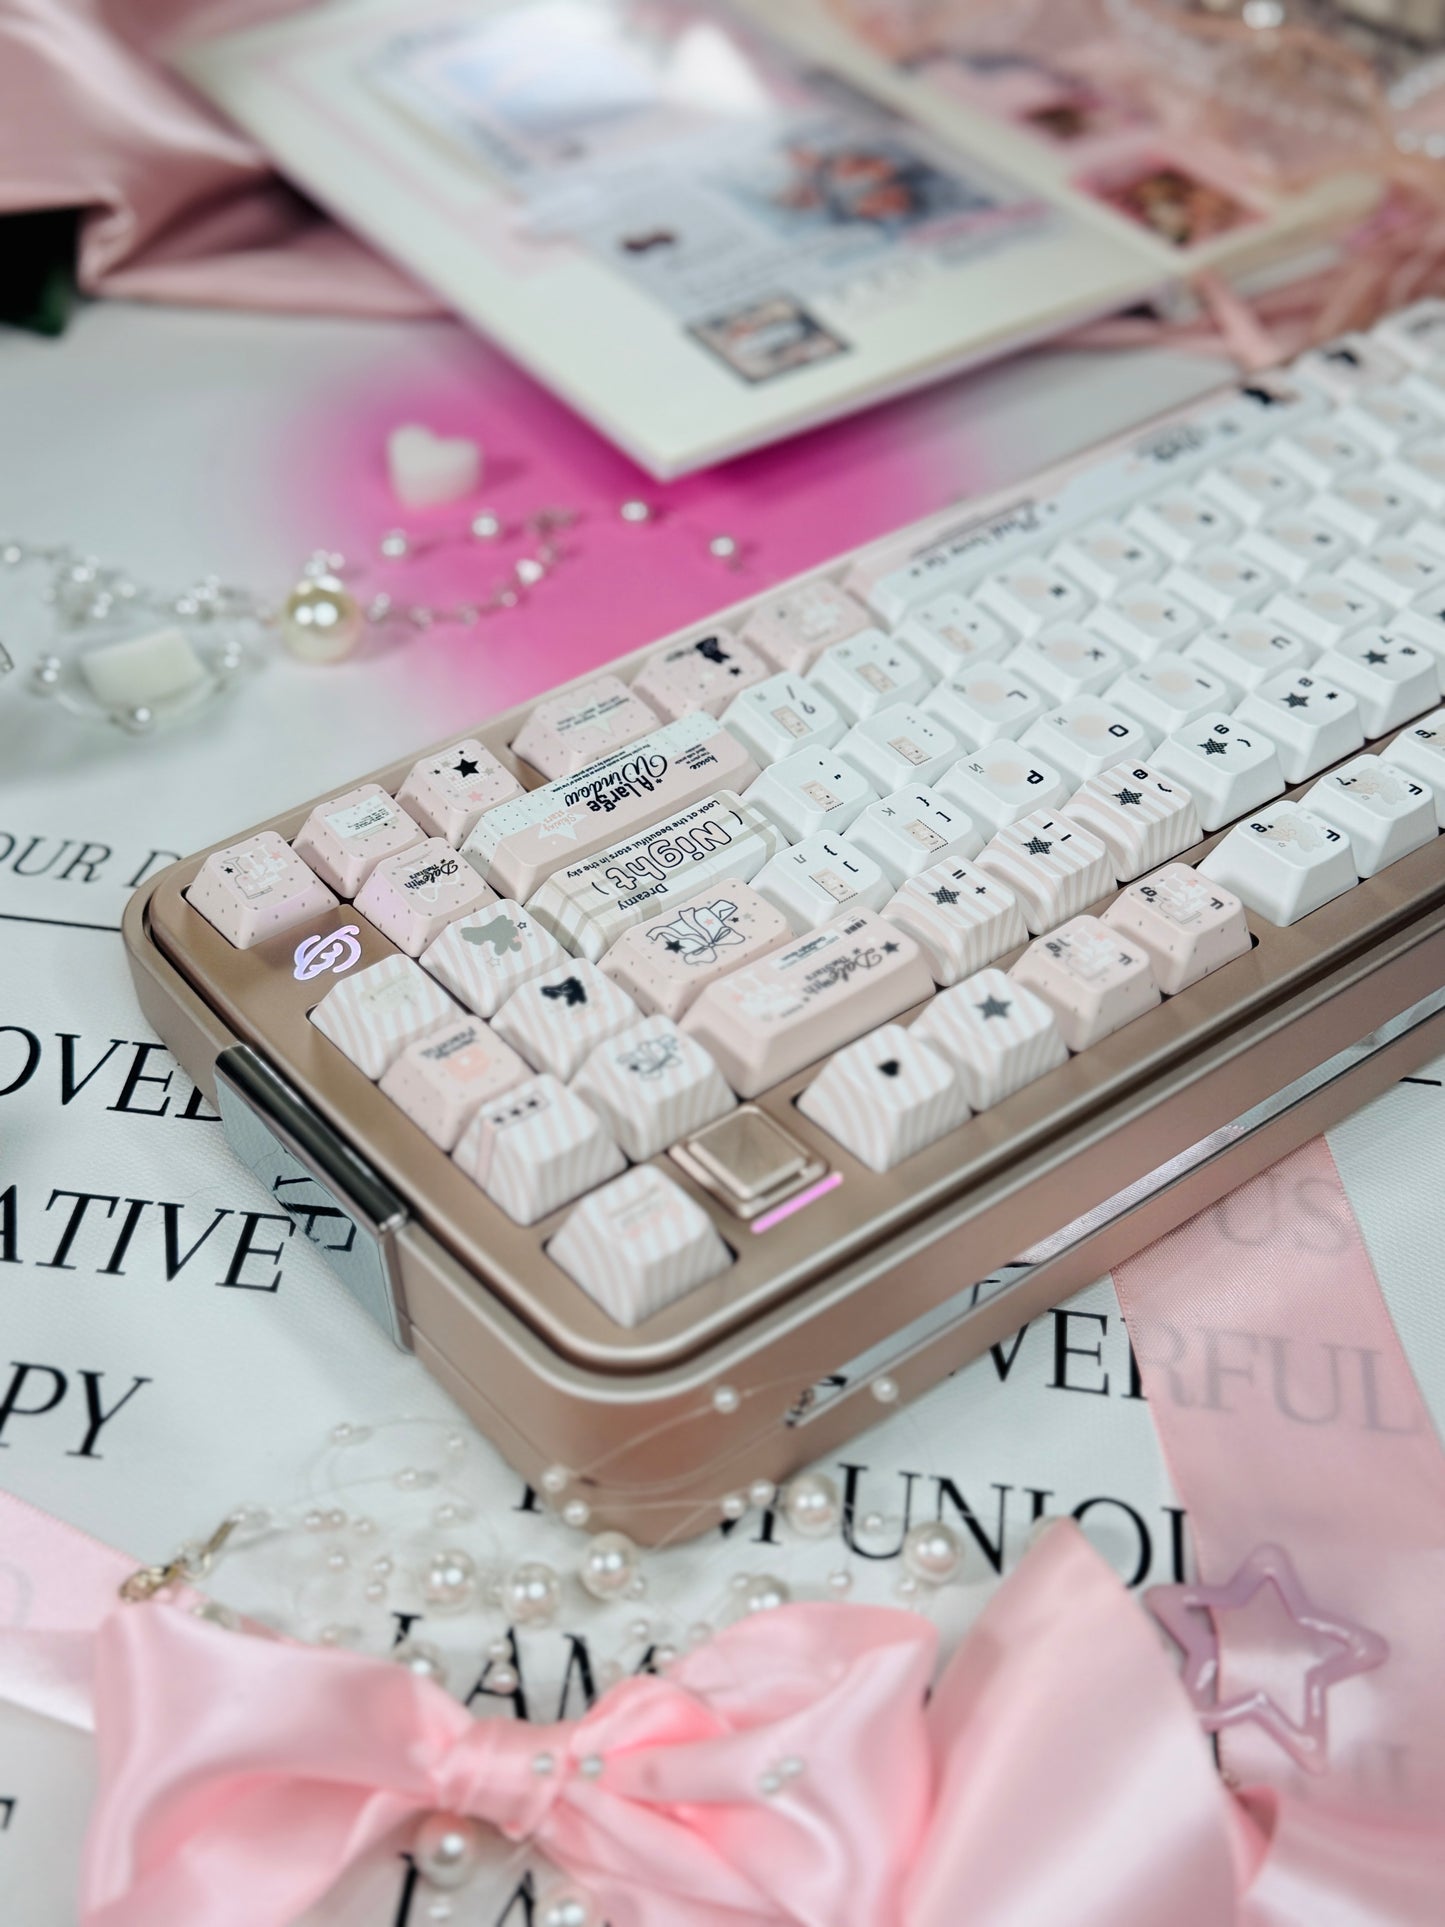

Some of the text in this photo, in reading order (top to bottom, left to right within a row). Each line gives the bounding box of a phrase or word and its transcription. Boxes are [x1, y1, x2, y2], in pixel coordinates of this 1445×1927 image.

[1214, 724, 1230, 734] 9
[690, 754, 719, 770] house
[564, 754, 668, 807] Window
[1026, 770, 1044, 784] P
[587, 775, 655, 812] A large
[1409, 783, 1423, 796] F
[566, 800, 720, 878] Look at the beautiful stars in the sky
[1326, 829, 1341, 842] F
[605, 820, 732, 890] Night
[618, 883, 669, 910] Dreamy
[1209, 897, 1225, 910] F
